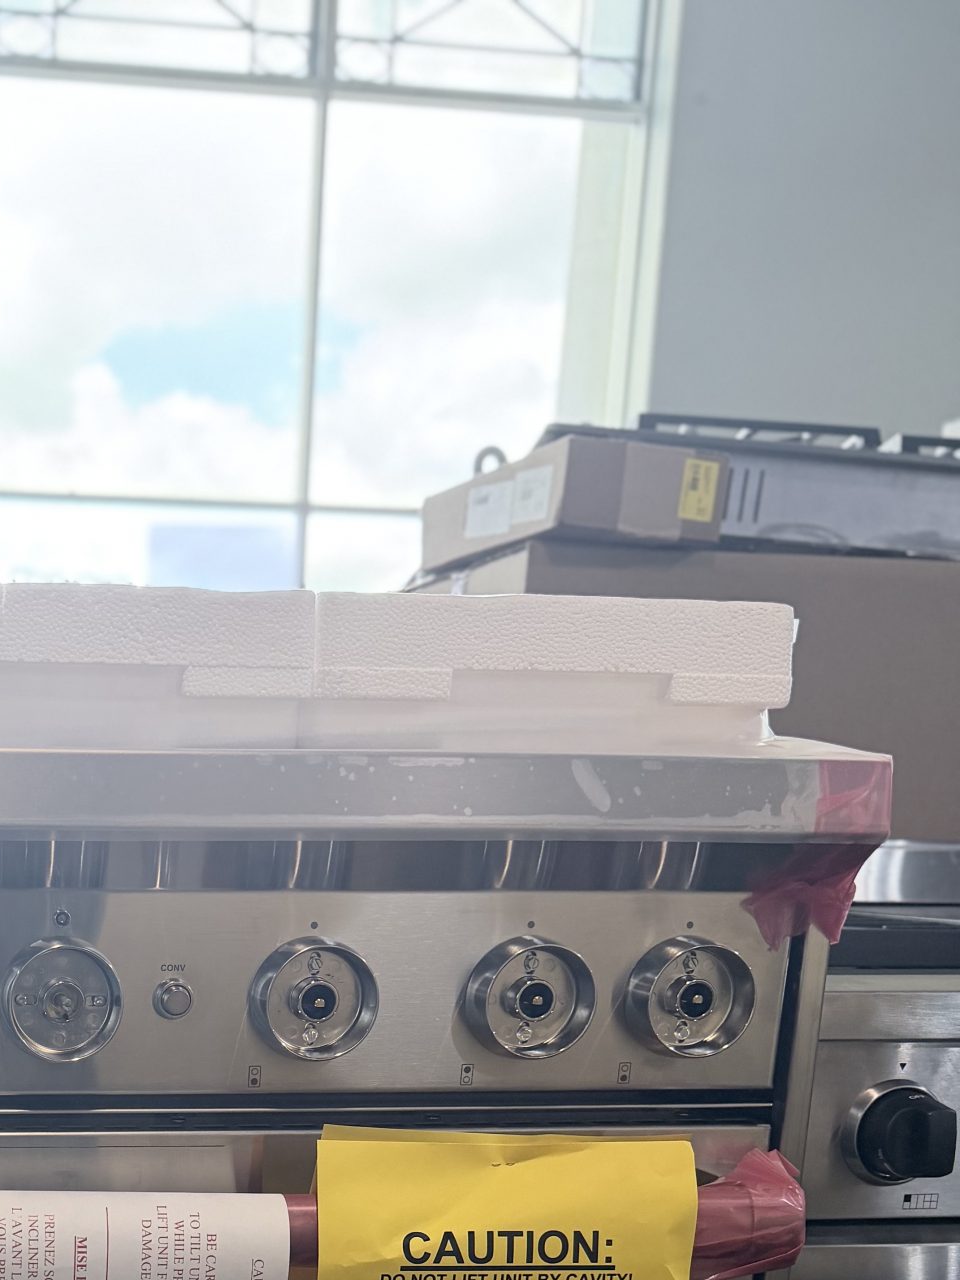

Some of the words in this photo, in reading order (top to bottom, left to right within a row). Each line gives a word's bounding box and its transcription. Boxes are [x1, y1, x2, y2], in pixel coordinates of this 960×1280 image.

[160, 964, 186, 972] CONV
[156, 1205, 168, 1232] LIFT
[189, 1212, 201, 1230] TO
[11, 1207, 23, 1269] L'AVANT
[27, 1215, 39, 1279] INCLINER
[44, 1214, 55, 1266] PRENEZ
[76, 1237, 88, 1272] MISE
[140, 1219, 152, 1280] DAMAGE
[157, 1236, 169, 1270] UNIT
[173, 1220, 185, 1265] WHILE
[190, 1233, 201, 1264] TILT
[206, 1234, 217, 1251] BE
[402, 1230, 613, 1264] CAUTION:
